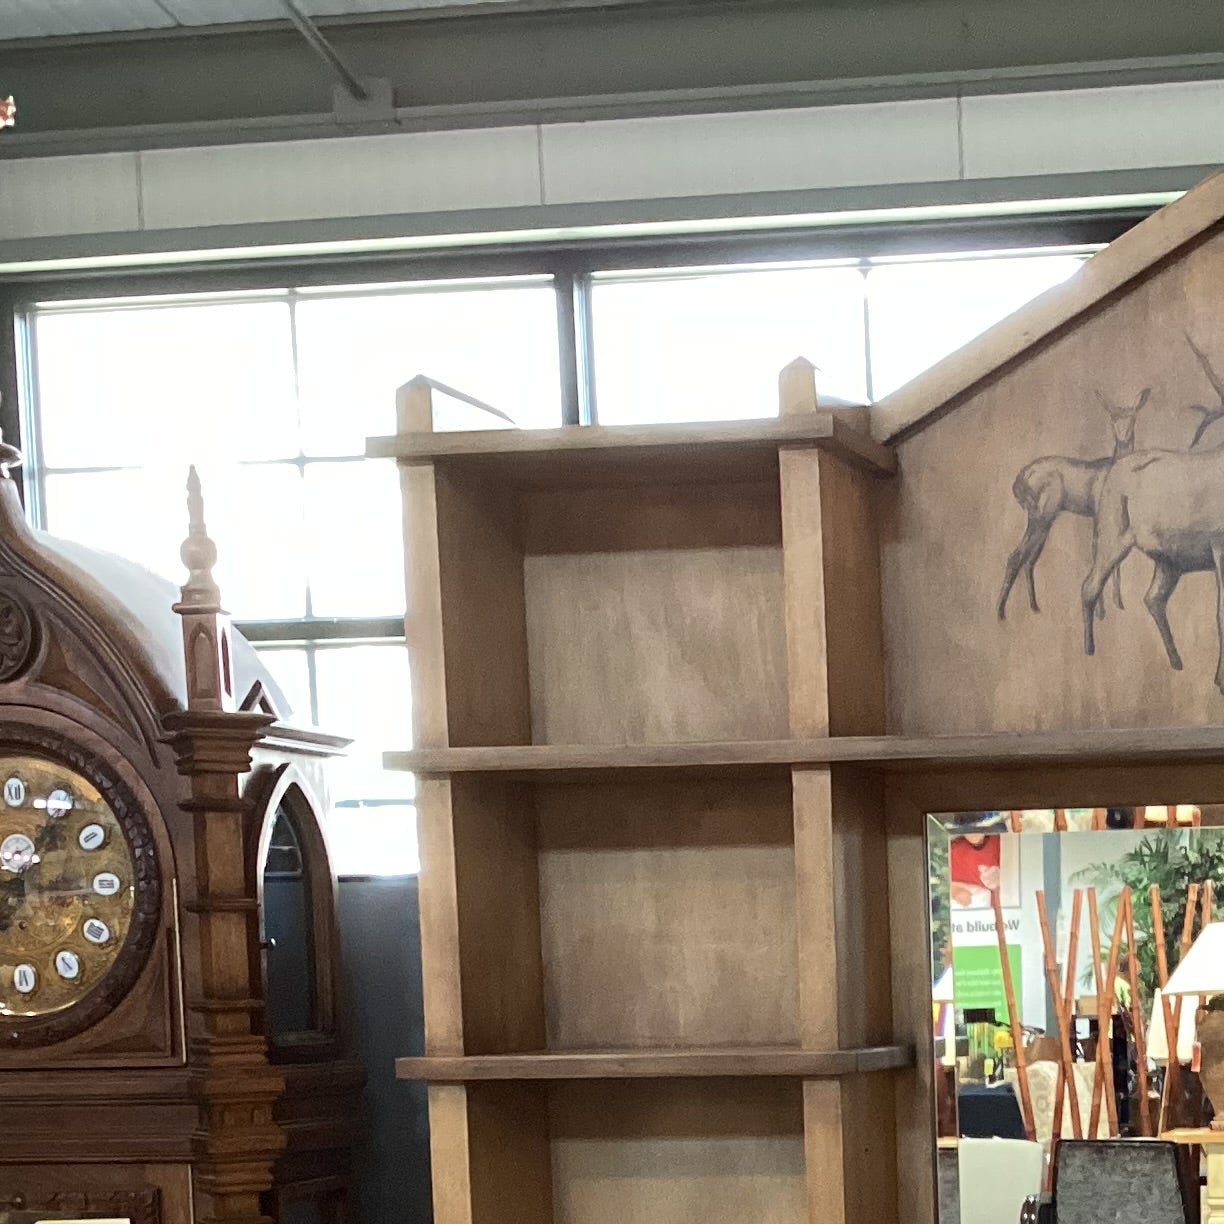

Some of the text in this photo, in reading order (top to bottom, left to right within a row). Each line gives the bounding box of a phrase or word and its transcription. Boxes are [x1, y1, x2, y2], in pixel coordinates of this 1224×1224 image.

[7, 784, 21, 801] XII
[83, 831, 98, 844] II
[98, 879, 115, 889] III
